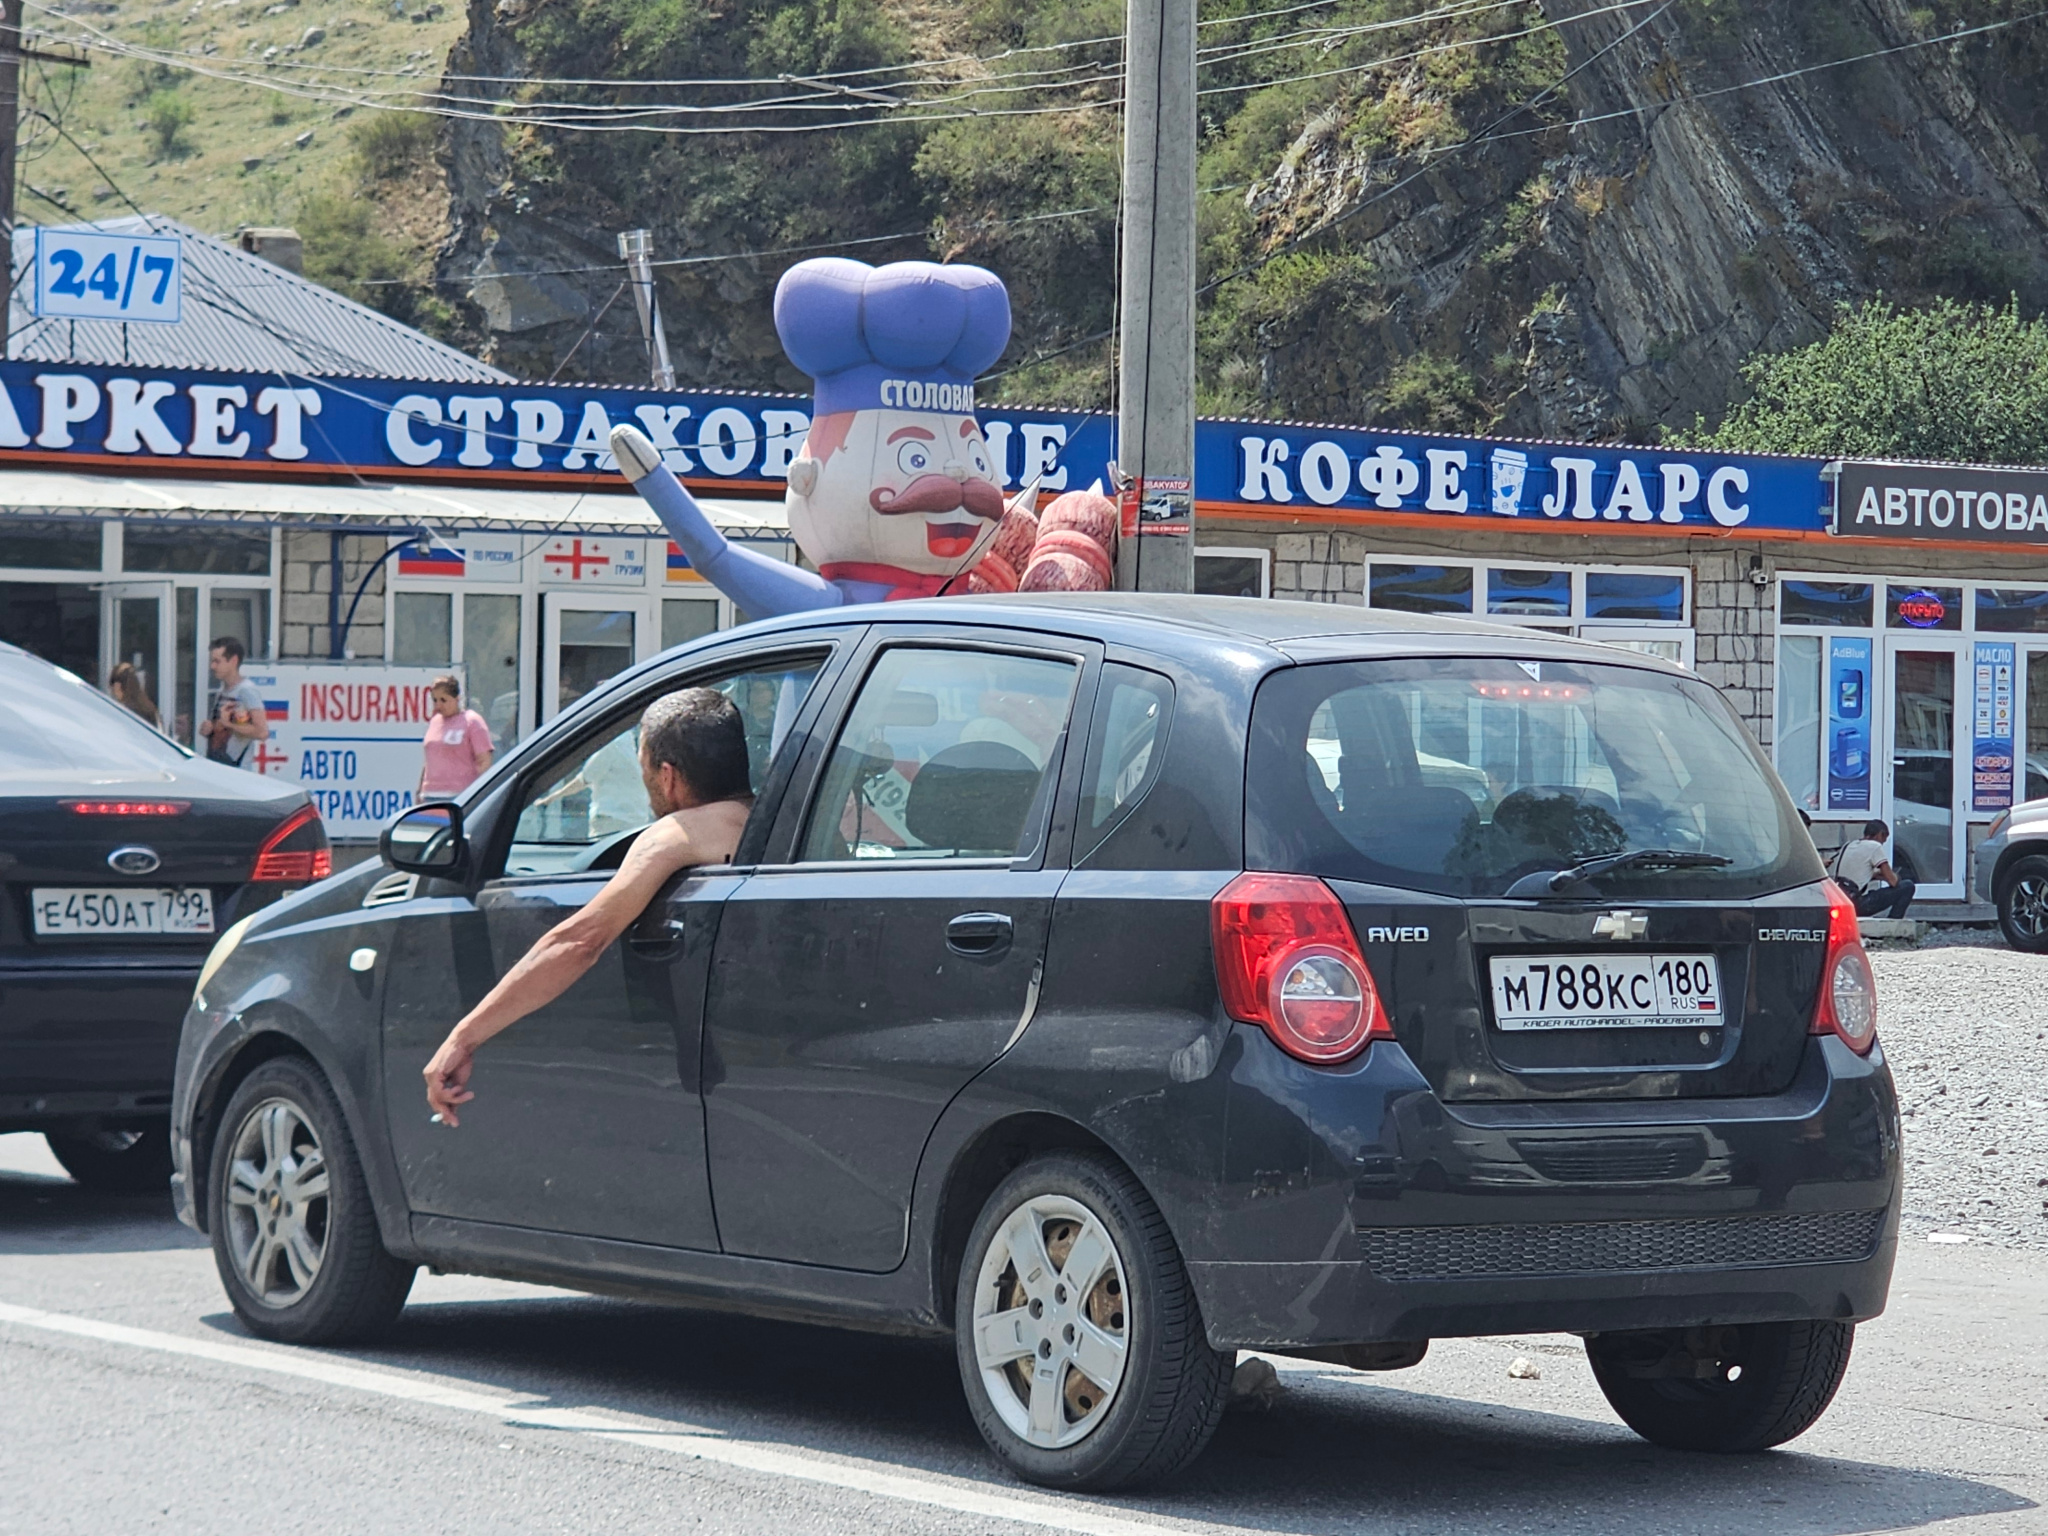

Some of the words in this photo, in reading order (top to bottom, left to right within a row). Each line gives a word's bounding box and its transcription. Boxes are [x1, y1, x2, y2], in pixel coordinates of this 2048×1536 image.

[49, 246, 174, 310] 24/7
[1240, 437, 1468, 513] КОФЕ
[1542, 457, 1749, 526] ЛАРС
[1856, 486, 2048, 532] АВТОТОВА
[485, 551, 514, 562] РОССИИ
[624, 550, 635, 560] ПО
[615, 564, 643, 576] ГРУЗИИ
[1899, 602, 1944, 619] ОТКРЫТО
[1976, 648, 2011, 663] МАСЛО
[300, 751, 357, 780] АВТО
[308, 790, 414, 820] ТРАХОВА
[161, 892, 204, 918] 799
[1368, 927, 1430, 942] AVEO
[1758, 928, 1826, 942] CHEVROLET
[1658, 961, 1709, 996] 180
[1671, 996, 1697, 1010] RUS
